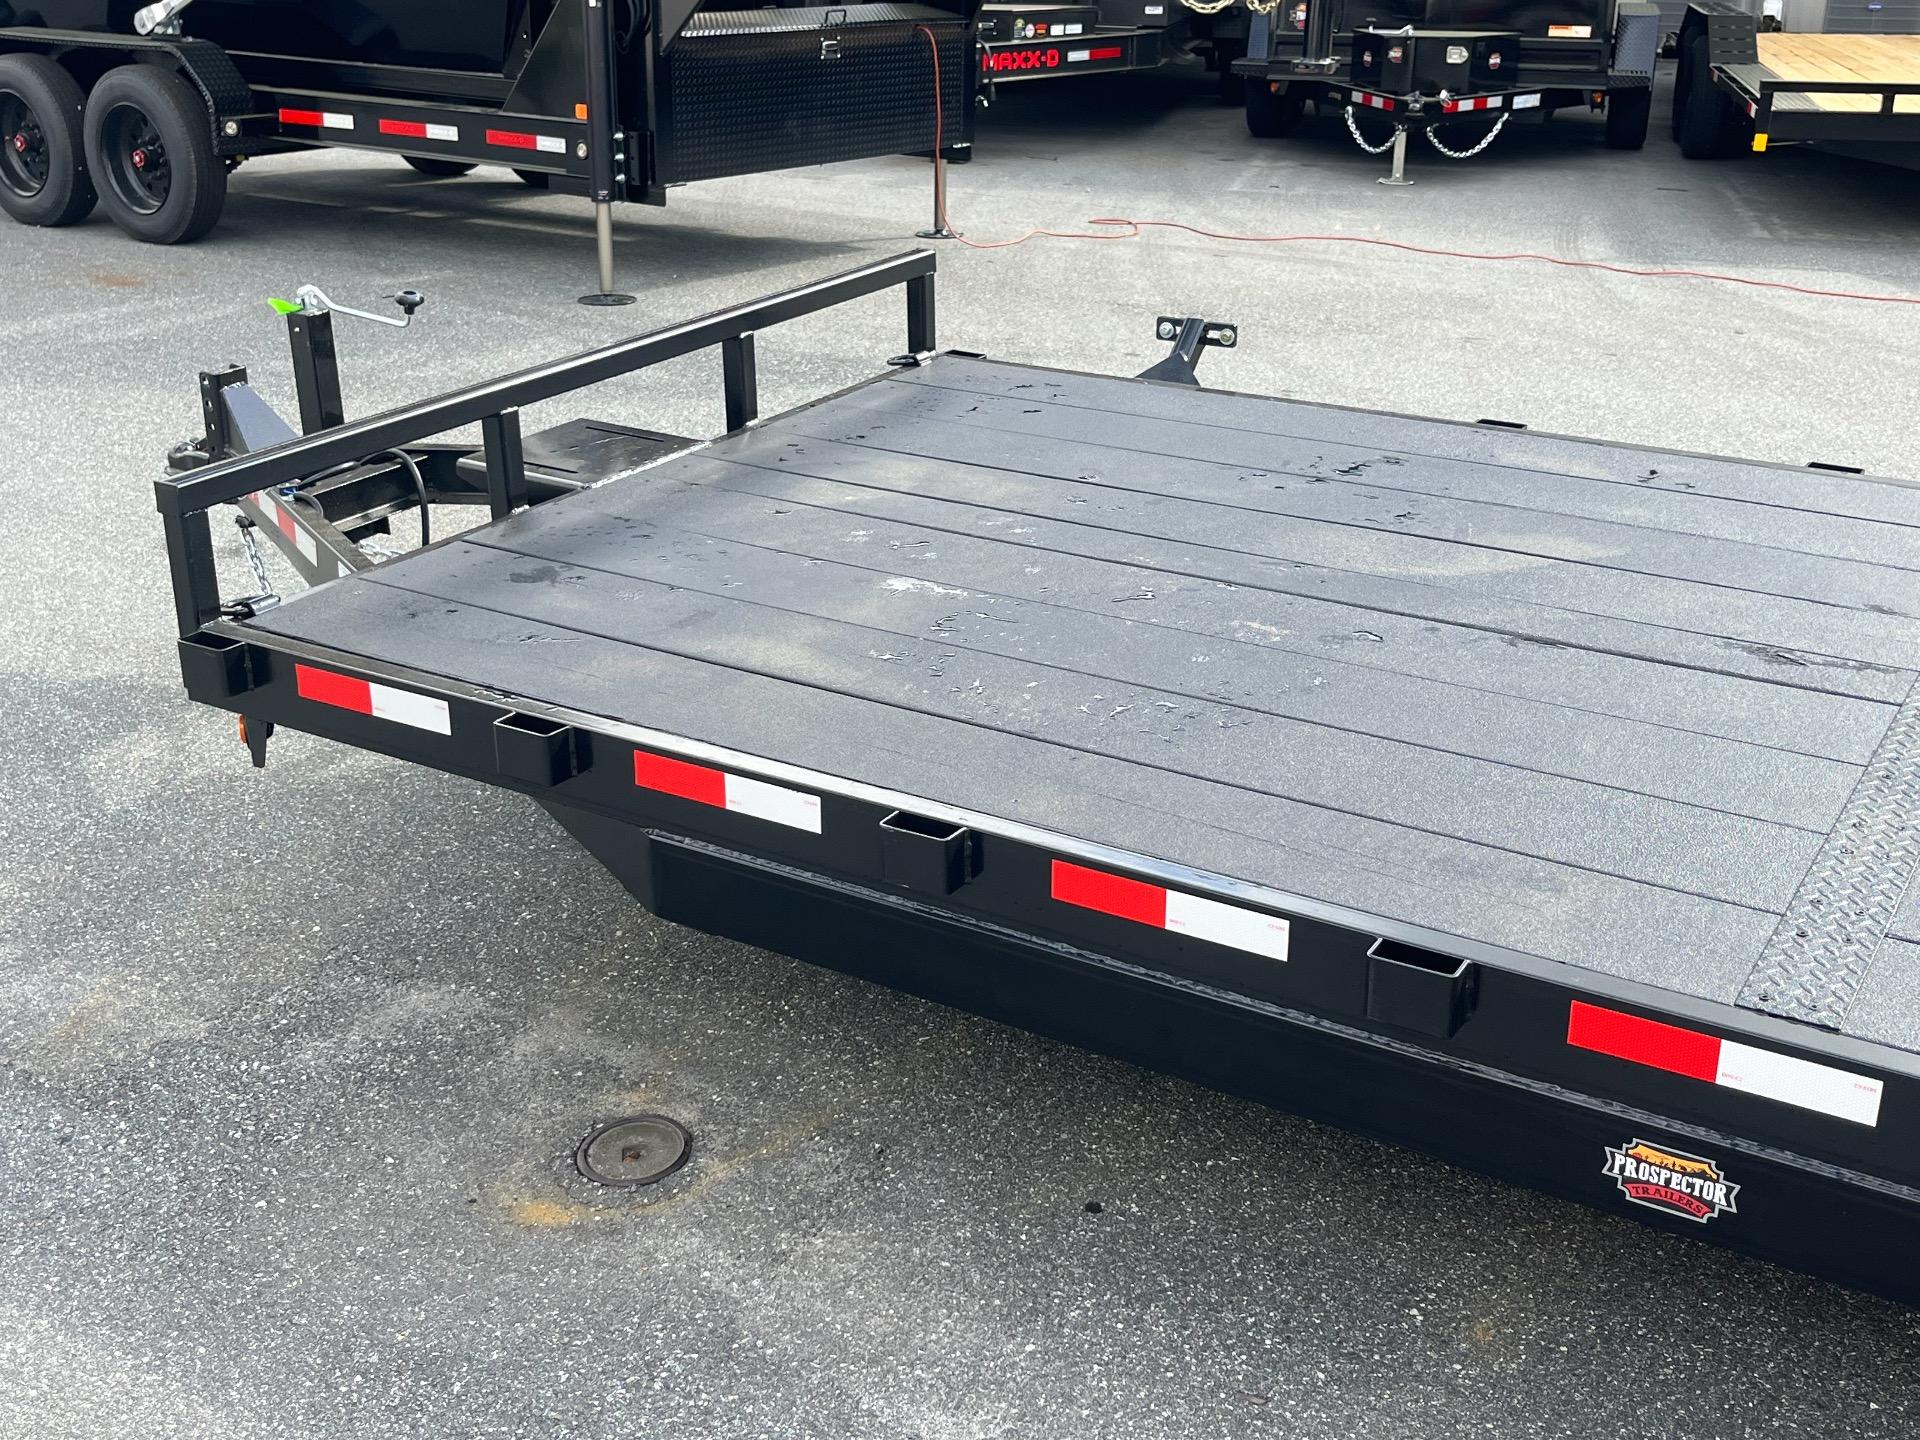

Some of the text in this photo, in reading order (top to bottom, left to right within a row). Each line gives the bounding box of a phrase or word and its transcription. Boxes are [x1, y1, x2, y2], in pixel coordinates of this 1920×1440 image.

[983, 49, 1060, 71] MAXX-D
[1612, 1152, 1728, 1206] PROSPECTOR
[1632, 1185, 1704, 1213] TRAILERS
